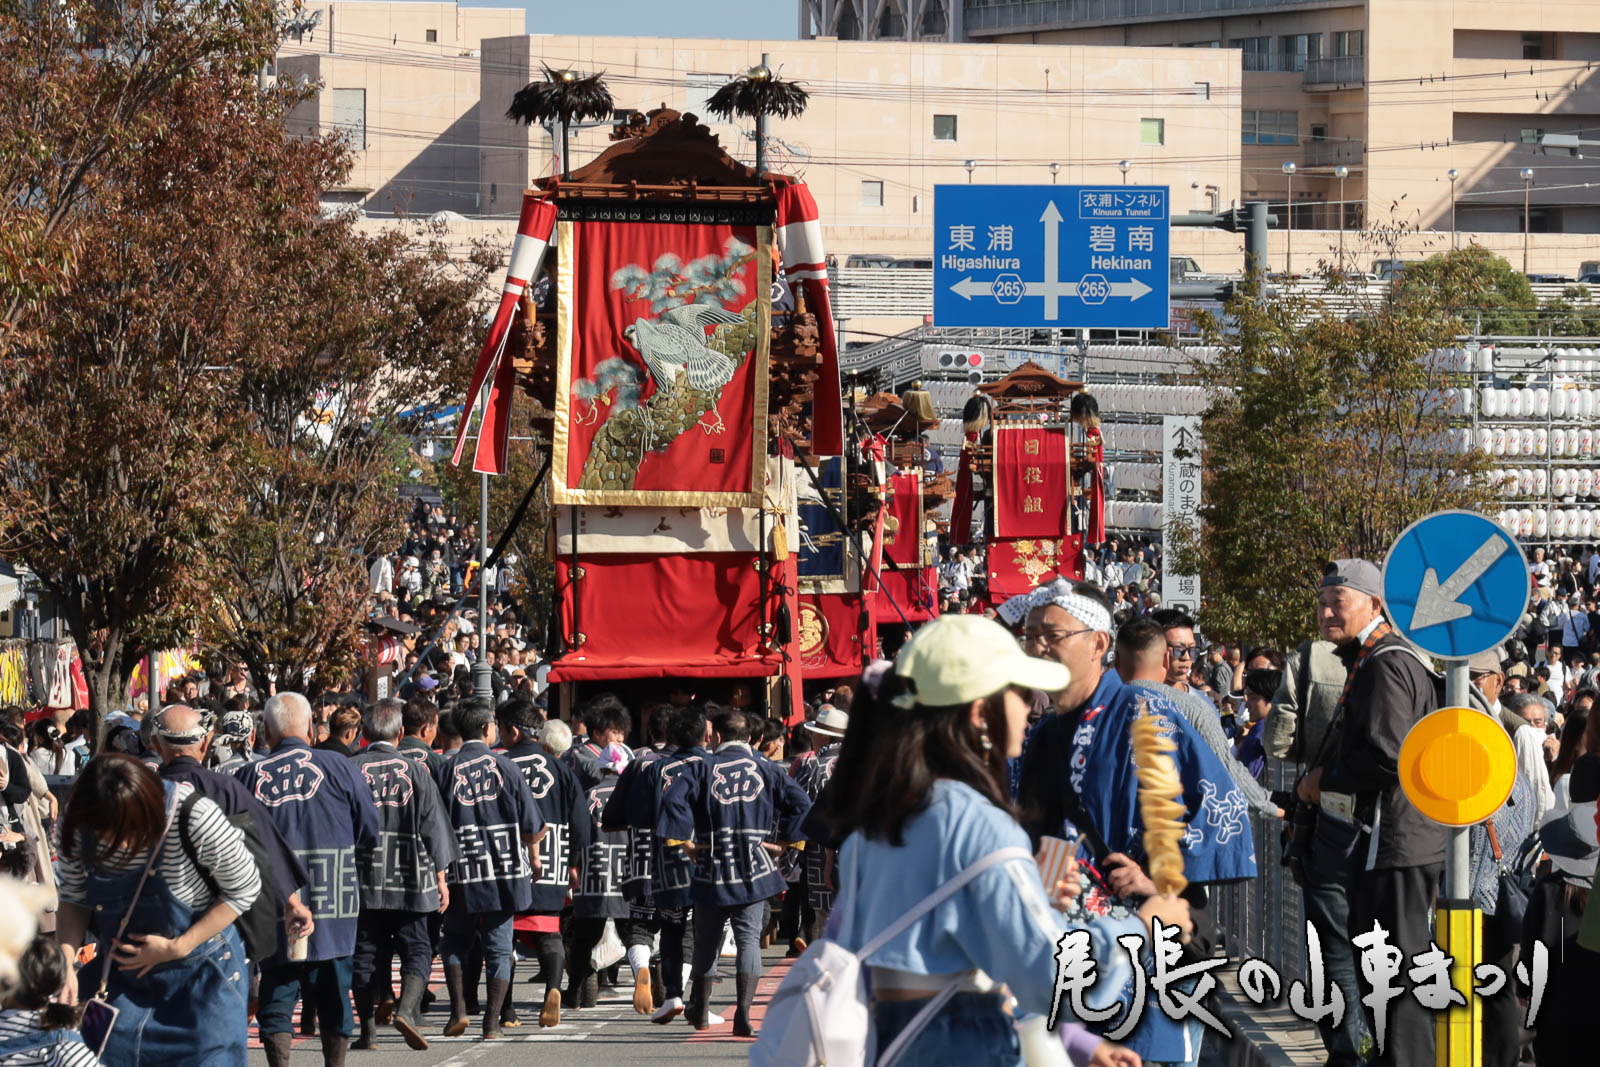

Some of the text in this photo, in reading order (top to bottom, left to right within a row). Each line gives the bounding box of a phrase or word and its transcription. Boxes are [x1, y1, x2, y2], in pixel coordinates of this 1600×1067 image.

[1083, 193, 1161, 208] 衣浦トンネル
[1093, 208, 1151, 217] Kinuura Tunnel
[948, 224, 1014, 252] 東浦
[1088, 225, 1155, 252] 碧南
[941, 255, 1021, 272] Higashiura
[1091, 255, 1152, 270] Hekinan
[996, 281, 1020, 296] 265
[1081, 282, 1106, 297] 265
[1024, 439, 1044, 513] 日役組
